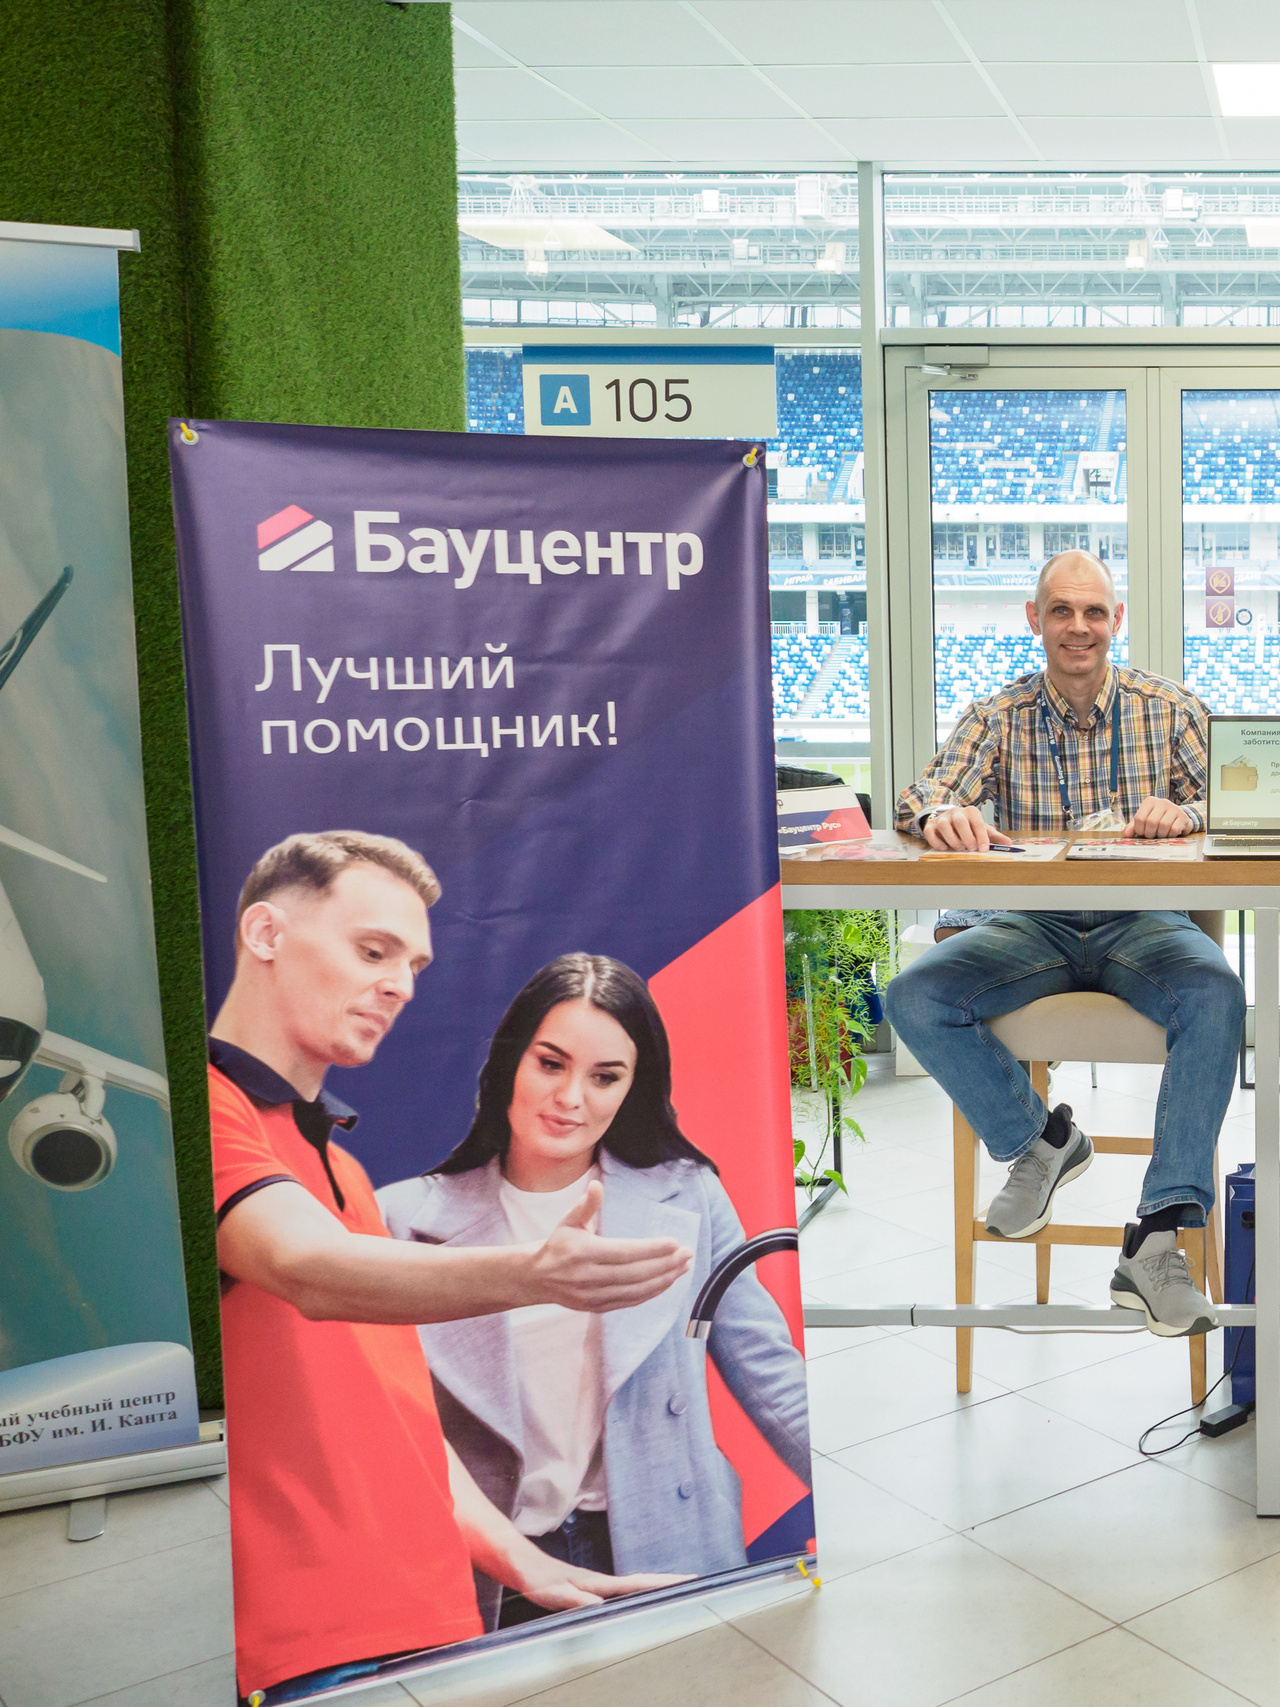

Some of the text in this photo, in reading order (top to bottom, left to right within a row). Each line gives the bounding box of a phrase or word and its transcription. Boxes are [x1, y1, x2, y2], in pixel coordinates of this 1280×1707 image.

[606, 379, 692, 422] 105
[354, 511, 704, 590] Бауцентр
[255, 643, 515, 703] Лучший
[261, 702, 618, 758] помощник!
[0, 1410, 178, 1447] БФУ им. И. Канта
[27, 1398, 113, 1427] учебный
[120, 1390, 176, 1408] центр
